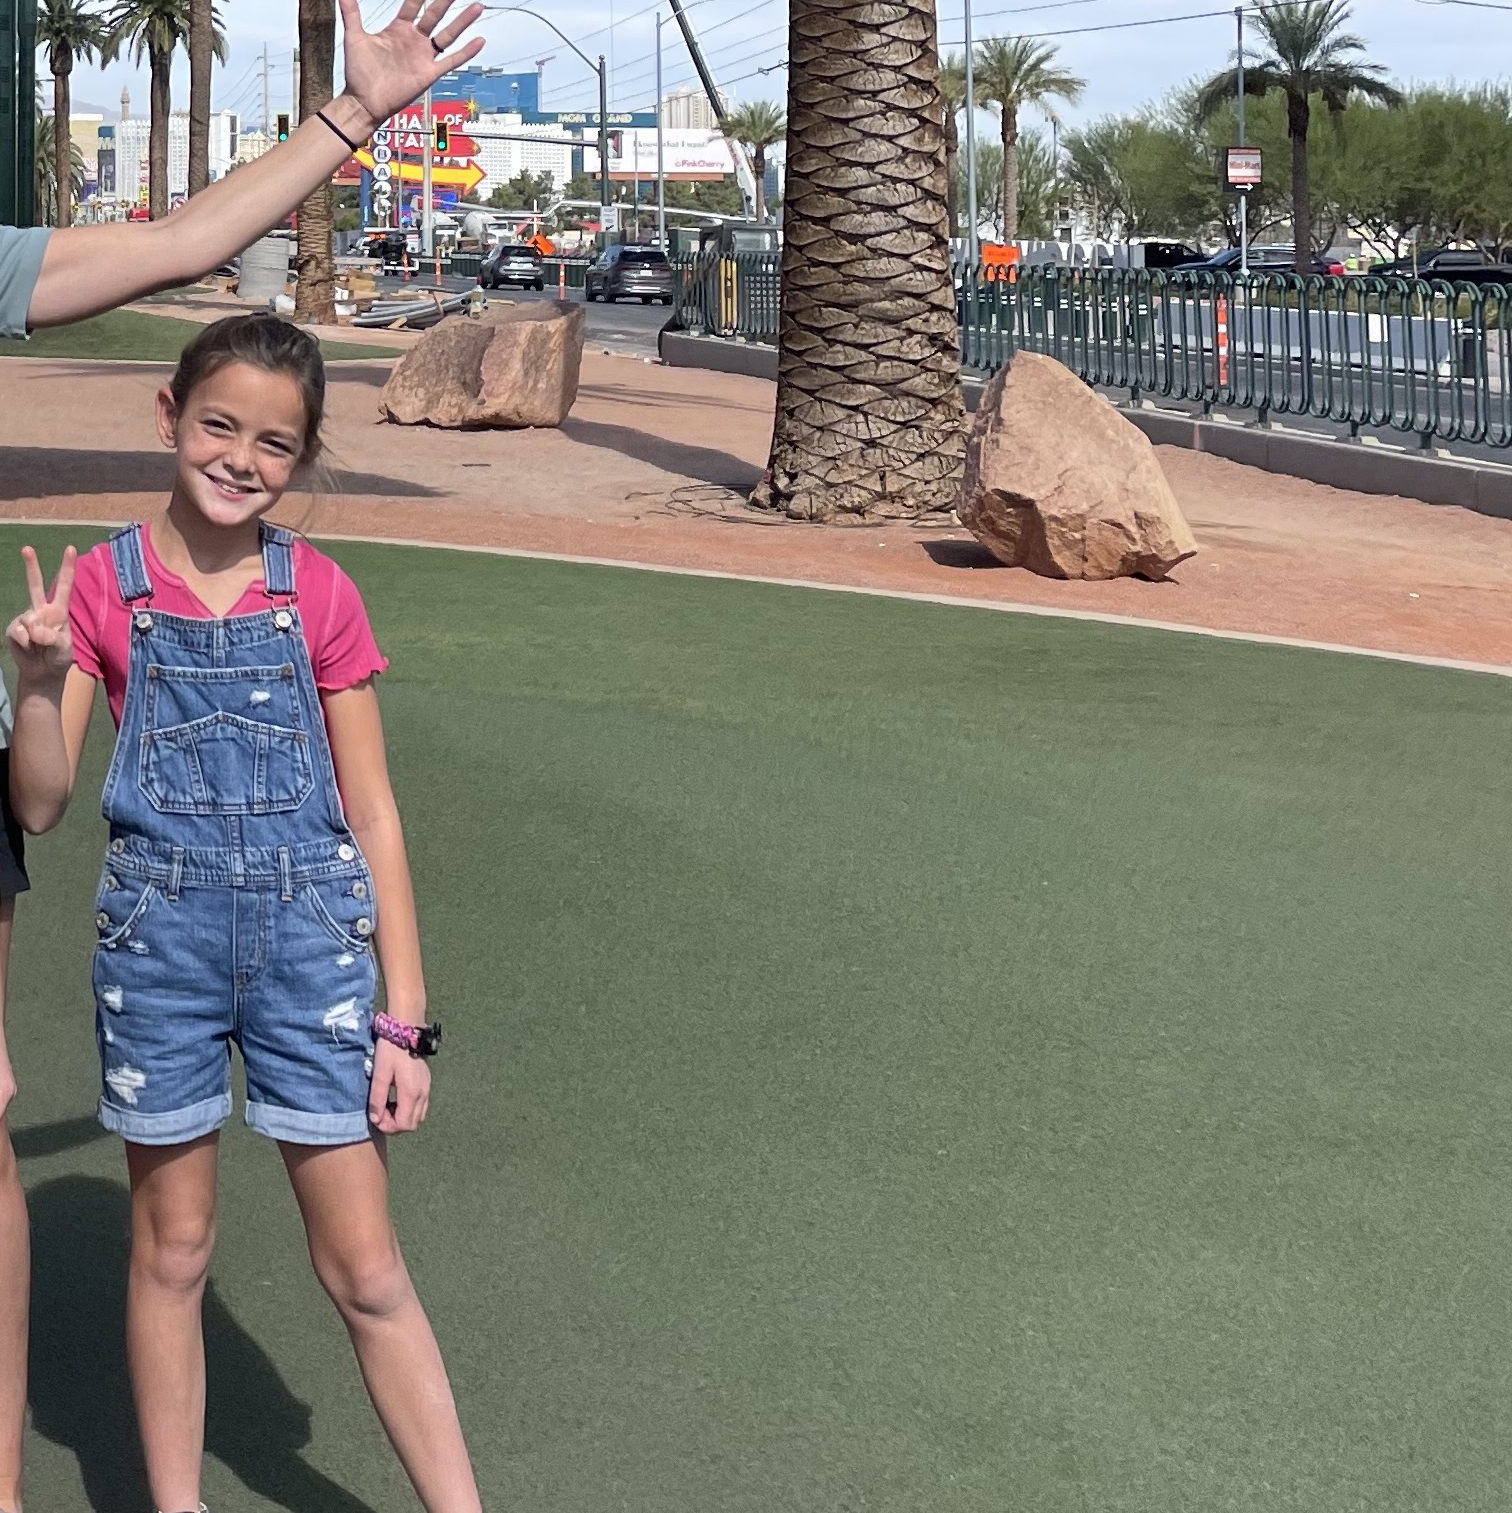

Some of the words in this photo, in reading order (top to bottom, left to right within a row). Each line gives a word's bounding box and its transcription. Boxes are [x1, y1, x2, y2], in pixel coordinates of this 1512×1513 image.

[444, 114, 463, 126] OF
[557, 113, 587, 123] MGM
[592, 113, 633, 123] GAND
